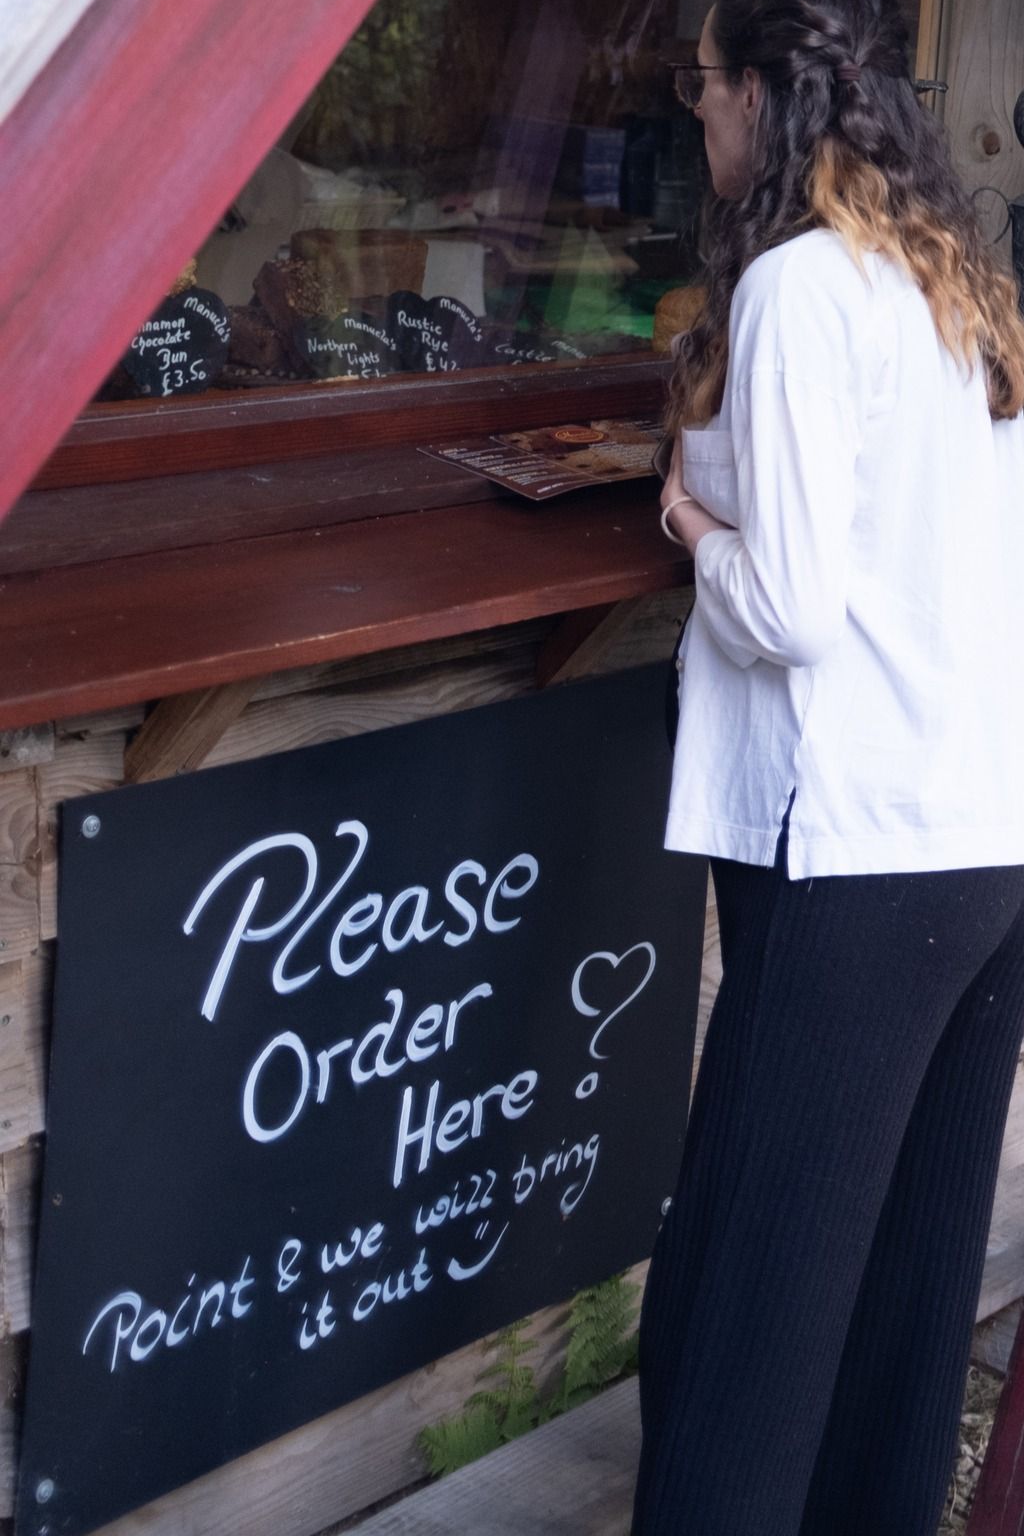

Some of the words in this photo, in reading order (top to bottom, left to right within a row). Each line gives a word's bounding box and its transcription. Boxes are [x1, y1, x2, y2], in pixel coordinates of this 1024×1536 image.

[138, 317, 185, 333] namon
[184, 296, 231, 343] Manuela's
[344, 317, 396, 351] Manuela's
[397, 310, 442, 335] Rustic
[440, 297, 483, 342] Manuela's
[131, 329, 191, 356] Chocolate
[156, 348, 188, 371] Bun
[307, 337, 358, 358] Northern
[421, 331, 449, 352] Rye
[161, 358, 207, 397] £3.50
[346, 351, 380, 369] Lights
[182, 820, 539, 1022] Please
[242, 982, 493, 1143] Order
[392, 1069, 538, 1188] Here
[82, 1256, 254, 1372] Point
[276, 1238, 303, 1292] &
[321, 1222, 384, 1273] we
[415, 1169, 494, 1235] will
[512, 1133, 600, 1217] bring
[299, 1303, 336, 1350] it
[353, 1252, 434, 1321] out
